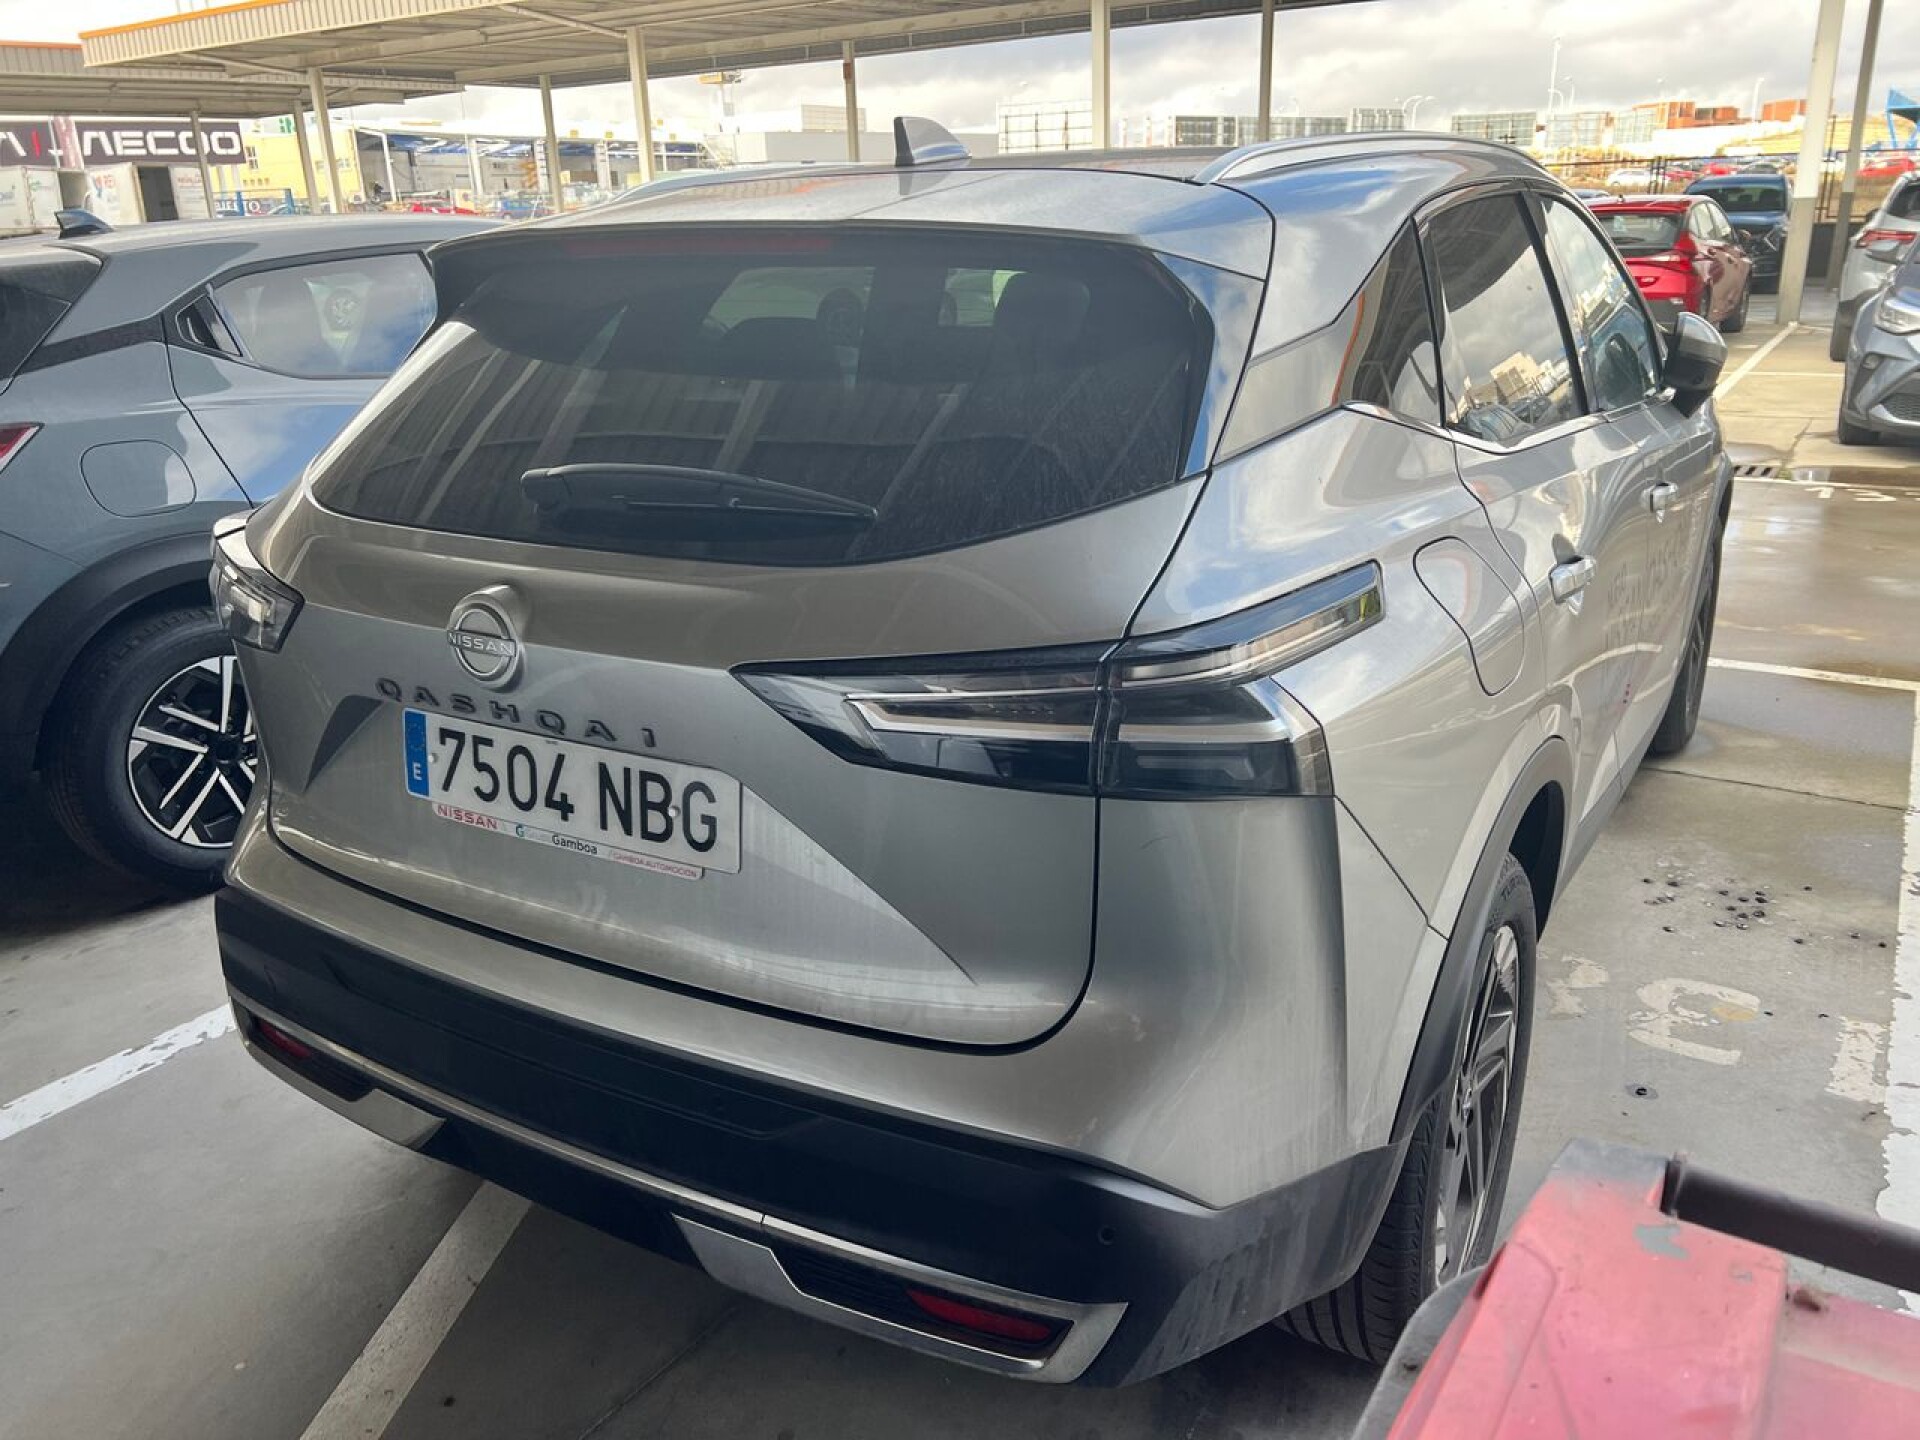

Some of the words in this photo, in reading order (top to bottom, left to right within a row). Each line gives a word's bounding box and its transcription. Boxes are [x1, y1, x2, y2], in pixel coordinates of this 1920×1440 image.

[449, 632, 514, 656] NISSAN
[375, 677, 657, 748] QASHQAI
[413, 762, 422, 780] E
[438, 727, 574, 822] 7504
[598, 761, 718, 853] NBG
[437, 803, 498, 830] NISSAN
[551, 834, 599, 856] Gamboa
